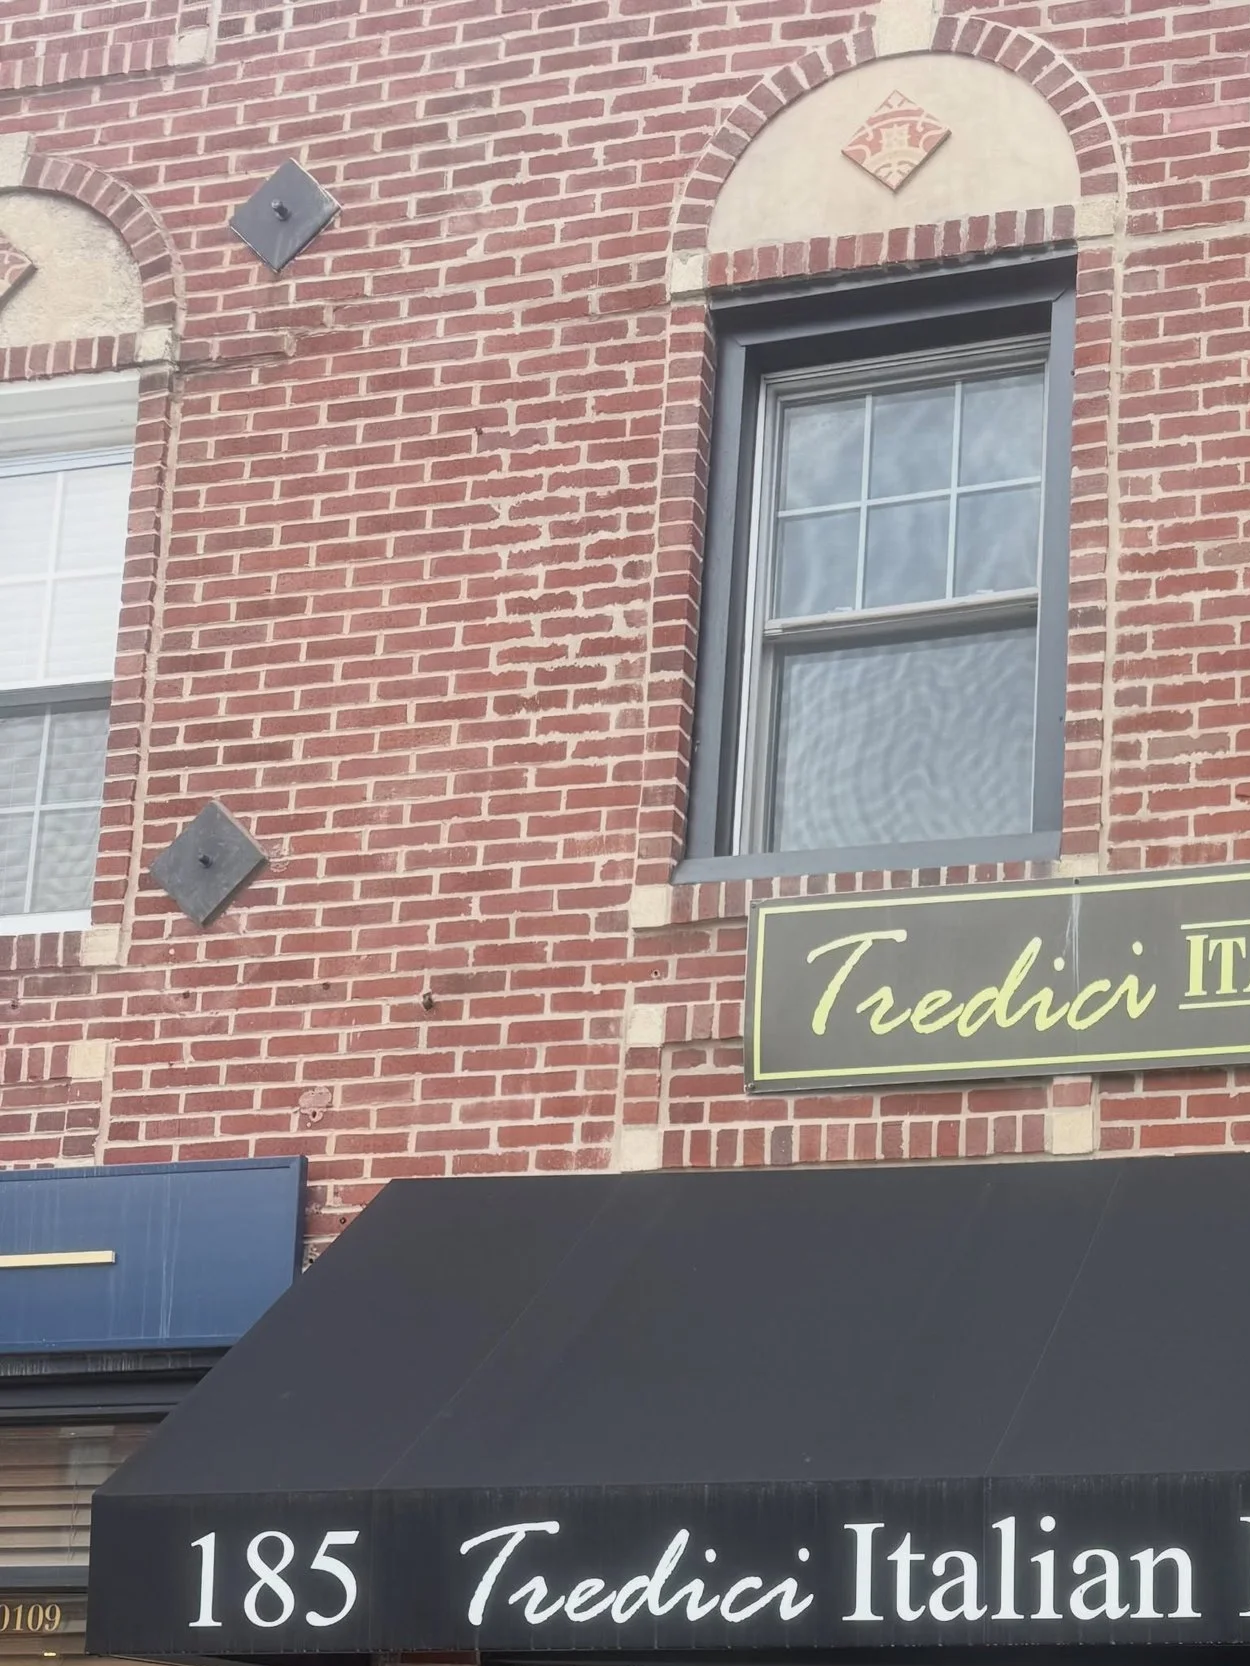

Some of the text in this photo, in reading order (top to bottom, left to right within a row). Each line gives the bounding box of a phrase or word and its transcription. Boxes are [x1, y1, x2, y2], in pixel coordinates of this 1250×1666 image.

[807, 928, 1156, 1038] Tredici
[188, 1530, 360, 1628] 185
[459, 1520, 815, 1626] Tredici
[841, 1515, 1202, 1622] Italian
